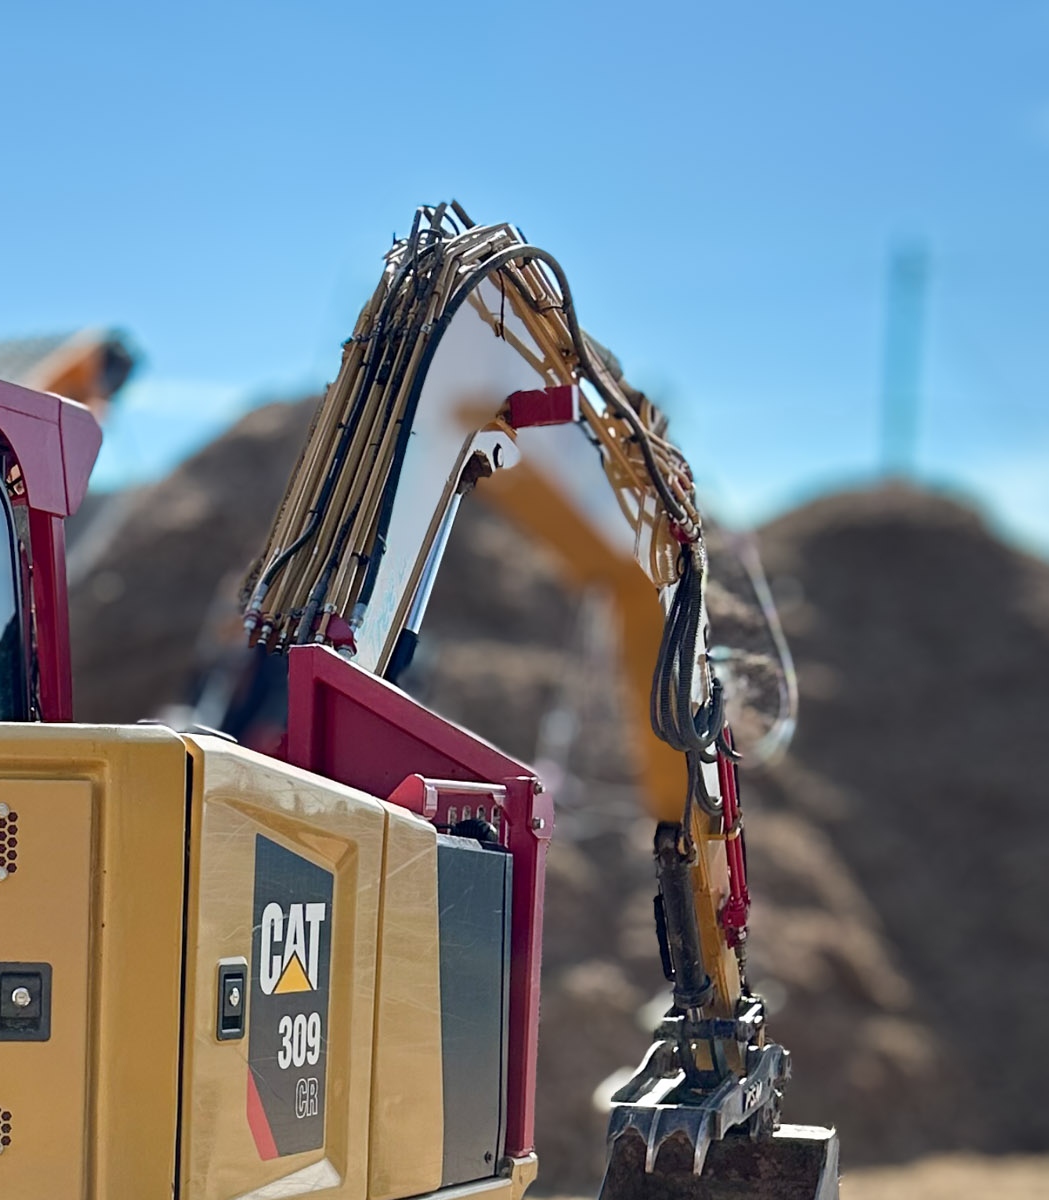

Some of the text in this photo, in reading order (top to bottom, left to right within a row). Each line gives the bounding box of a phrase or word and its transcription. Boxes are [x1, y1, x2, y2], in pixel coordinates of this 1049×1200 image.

[259, 902, 326, 995] CAT
[278, 1012, 321, 1069] 309
[296, 1077, 319, 1119] CR
